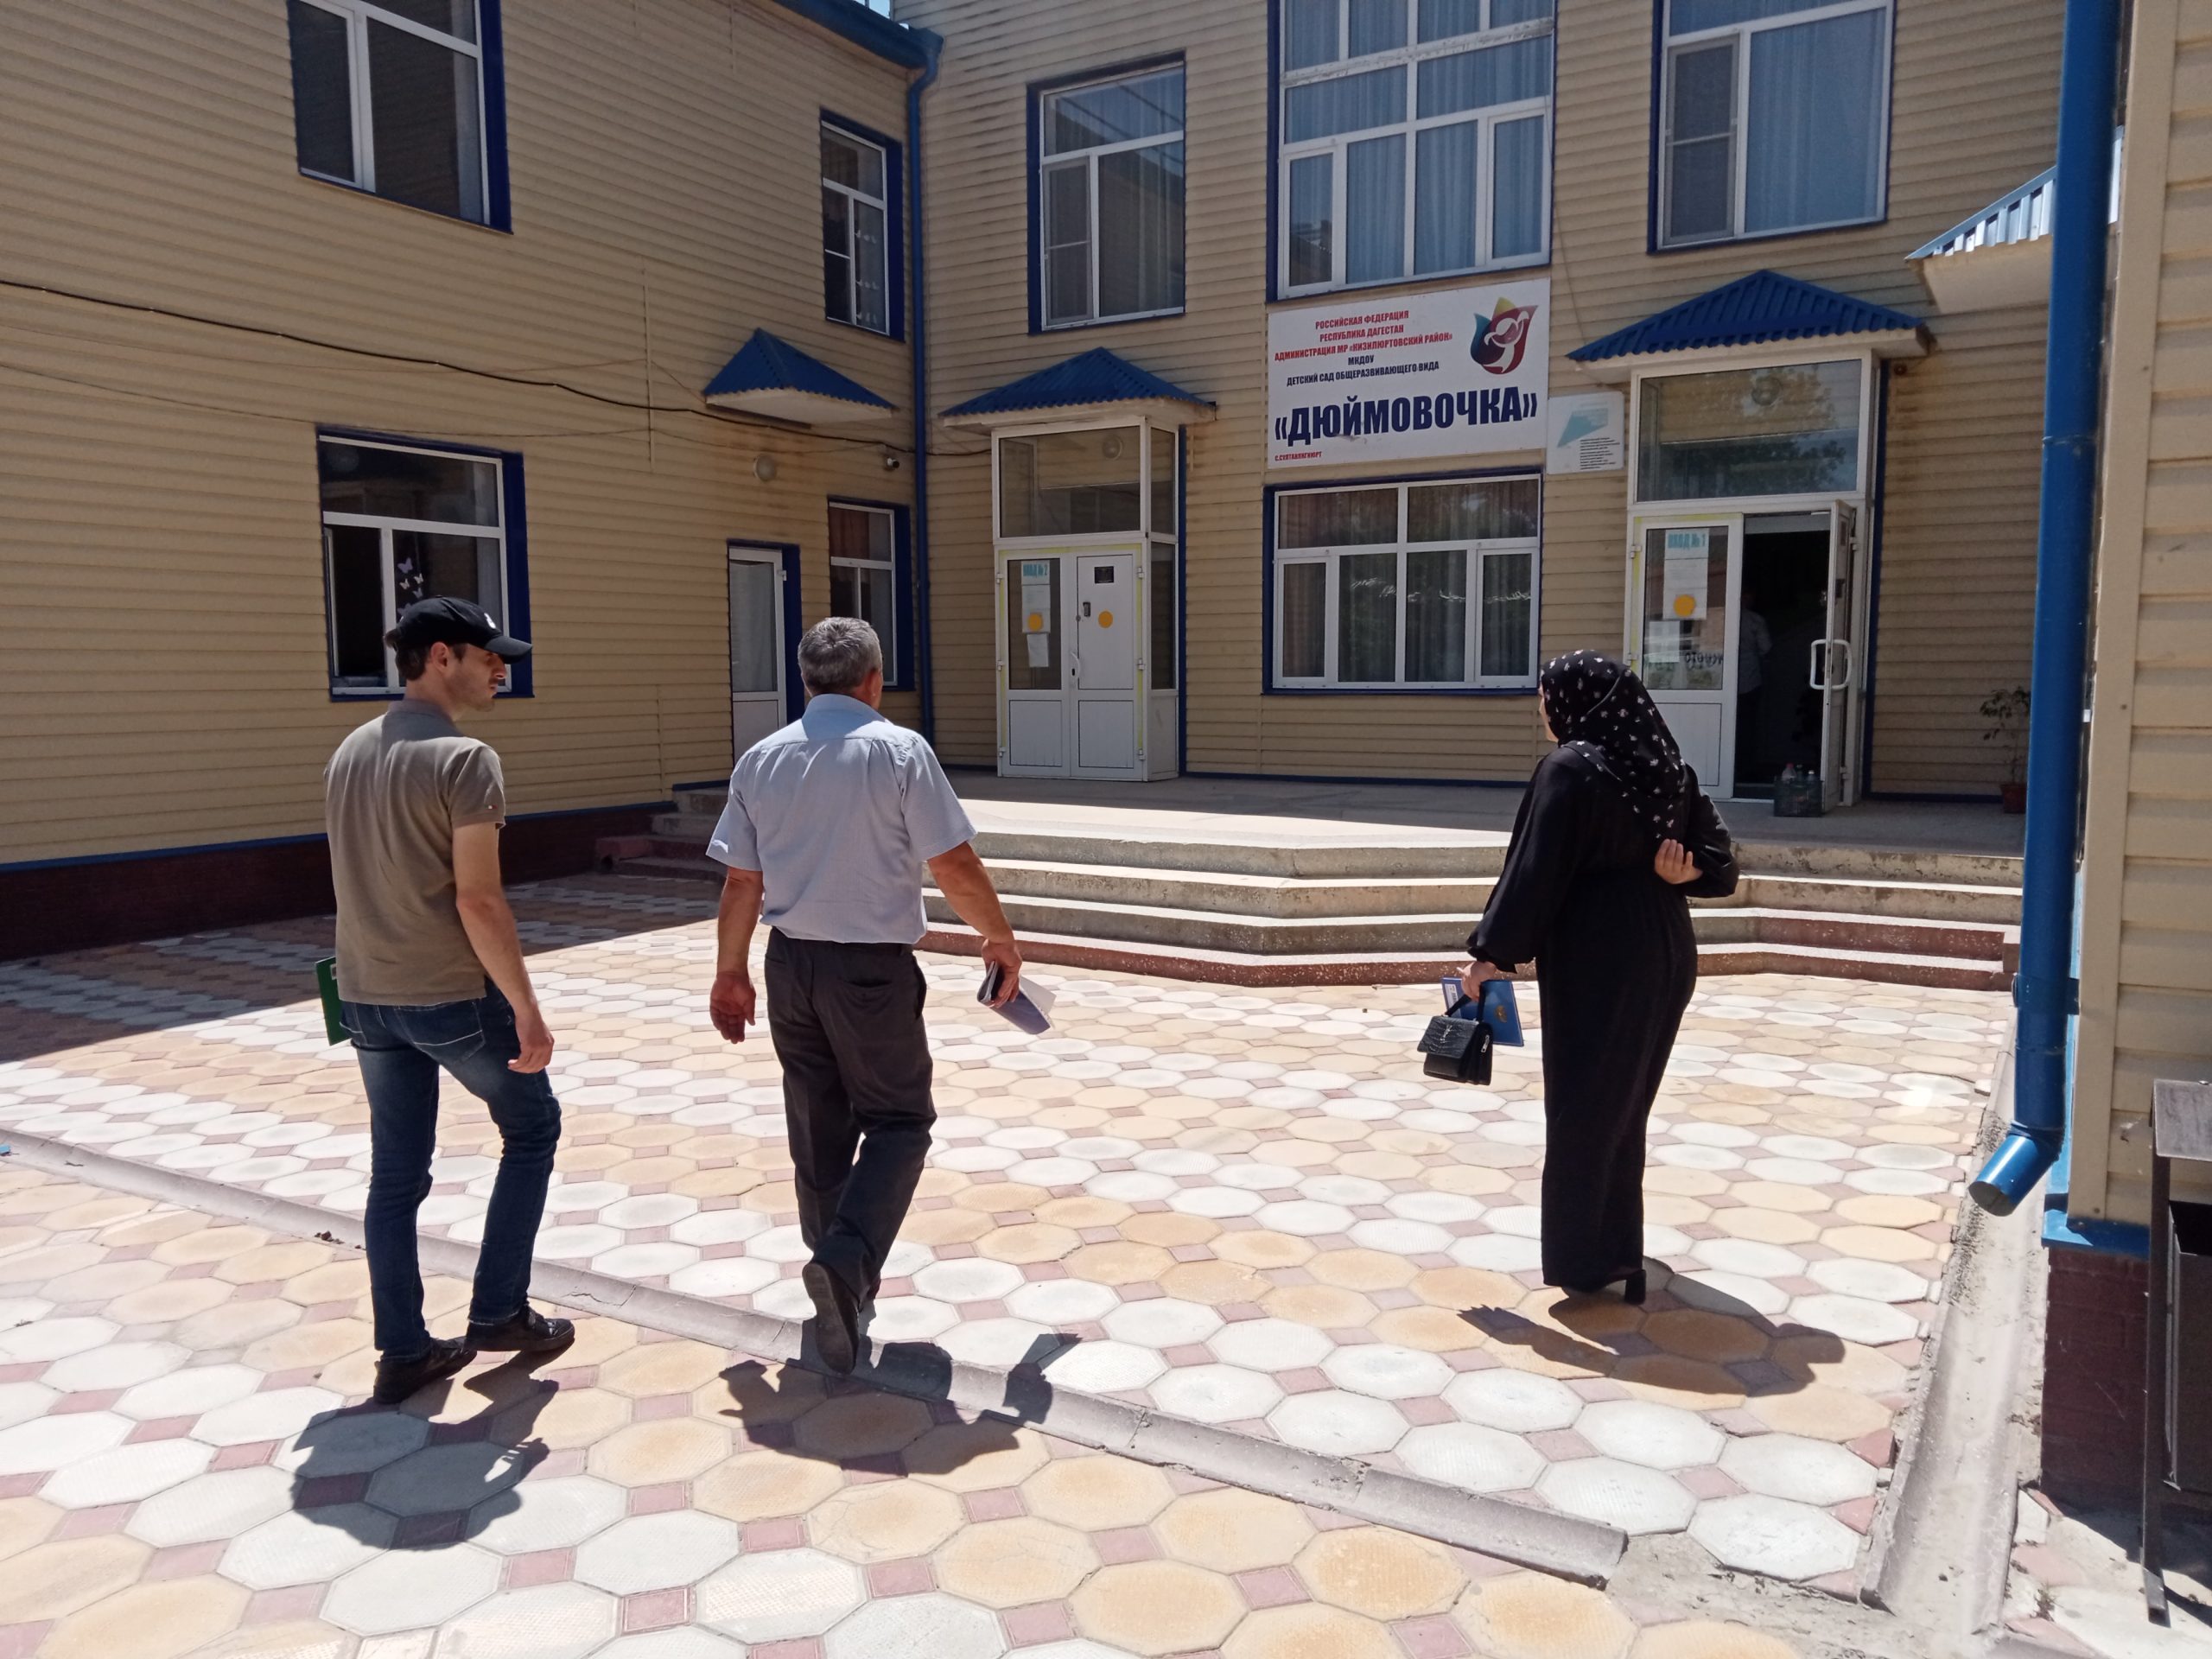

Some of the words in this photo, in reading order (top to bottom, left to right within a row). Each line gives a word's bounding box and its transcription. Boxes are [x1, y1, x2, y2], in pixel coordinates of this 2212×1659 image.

[1315, 316, 1363, 329] РОССИЙСКАЯ
[1363, 310, 1409, 323] ФЕДЕРАЦИЯ
[1319, 328, 1365, 342] РЕСПУБЛИКА
[1367, 324, 1404, 338] ДАГЕСТАН
[1274, 346, 1336, 361] АДМИНИСТРАЦИЯ
[1337, 344, 1348, 353] МР
[1424, 331, 1453, 344] РАЙОН»
[1348, 354, 1375, 365] МКДОУ
[1286, 372, 1319, 386] ДЕТСКИЙ
[1319, 372, 1335, 382] САД
[1335, 363, 1418, 380] ОБЩЕРАЗВИВАЮЩЕГО
[1418, 360, 1440, 372] ВИДА
[1274, 386, 1538, 447] «ДЮЙМОВОЧКА»
